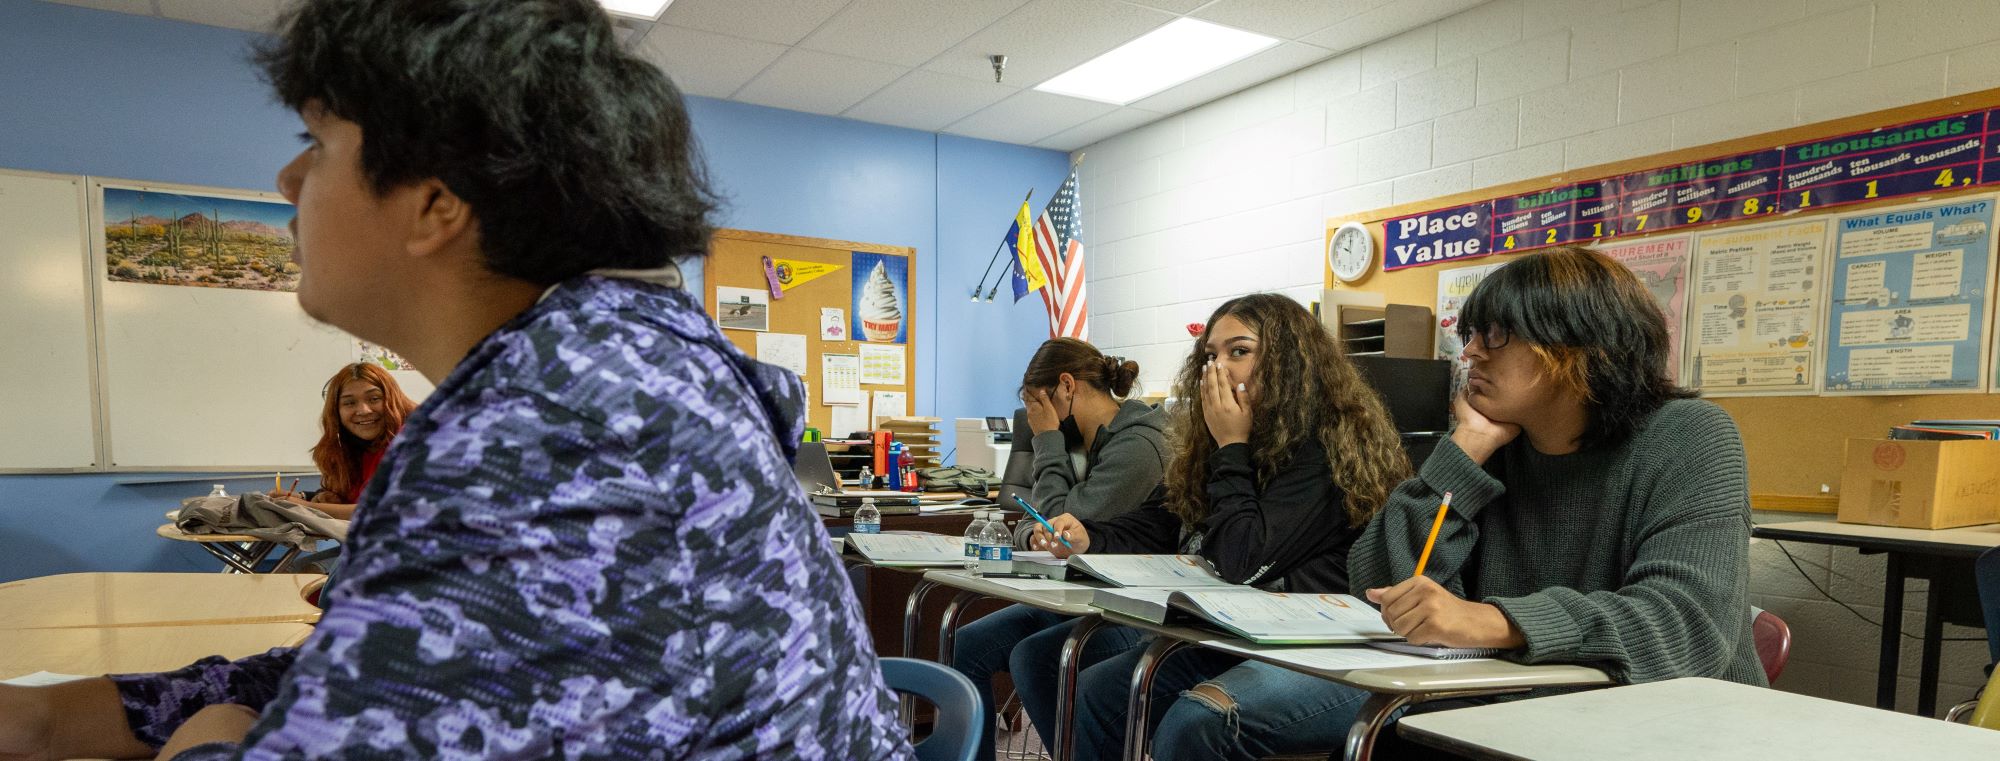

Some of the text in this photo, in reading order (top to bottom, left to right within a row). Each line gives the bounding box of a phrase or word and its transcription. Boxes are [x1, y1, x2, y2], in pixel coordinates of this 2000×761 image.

[1797, 119, 1967, 160] thousands
[1914, 139, 1980, 165] thousands
[1788, 161, 1833, 182] hundred
[1850, 157, 1870, 168] ten
[1851, 152, 1911, 176] thousands
[1648, 159, 1753, 187] millions
[1788, 166, 1843, 189] thousands
[1677, 187, 1693, 196] ten
[1728, 176, 1768, 195] millions
[1518, 187, 1595, 209] billions
[1632, 189, 1668, 207] hundred
[1678, 186, 1715, 204] millions
[1503, 235, 1515, 249] 4
[1545, 228, 1557, 243] 2
[1635, 214, 1649, 231] 7
[1687, 207, 1702, 224] 9
[1799, 190, 1811, 207] 1
[1865, 180, 1879, 199] 1
[1541, 210, 1552, 219] ten
[1582, 203, 1614, 217] billions
[1633, 197, 1667, 214] millions
[1502, 212, 1532, 228] hundred
[1541, 211, 1567, 226] billions
[1846, 202, 1987, 229] What Equals What?
[1399, 211, 1477, 240] Place
[1502, 220, 1529, 234] billions
[1394, 238, 1481, 265] Value
[1605, 240, 1684, 258] SUREMENT
[1925, 251, 1952, 259] WEIGHT
[1851, 262, 1882, 270] CAPACITY
[863, 319, 898, 332] TRY MATH
